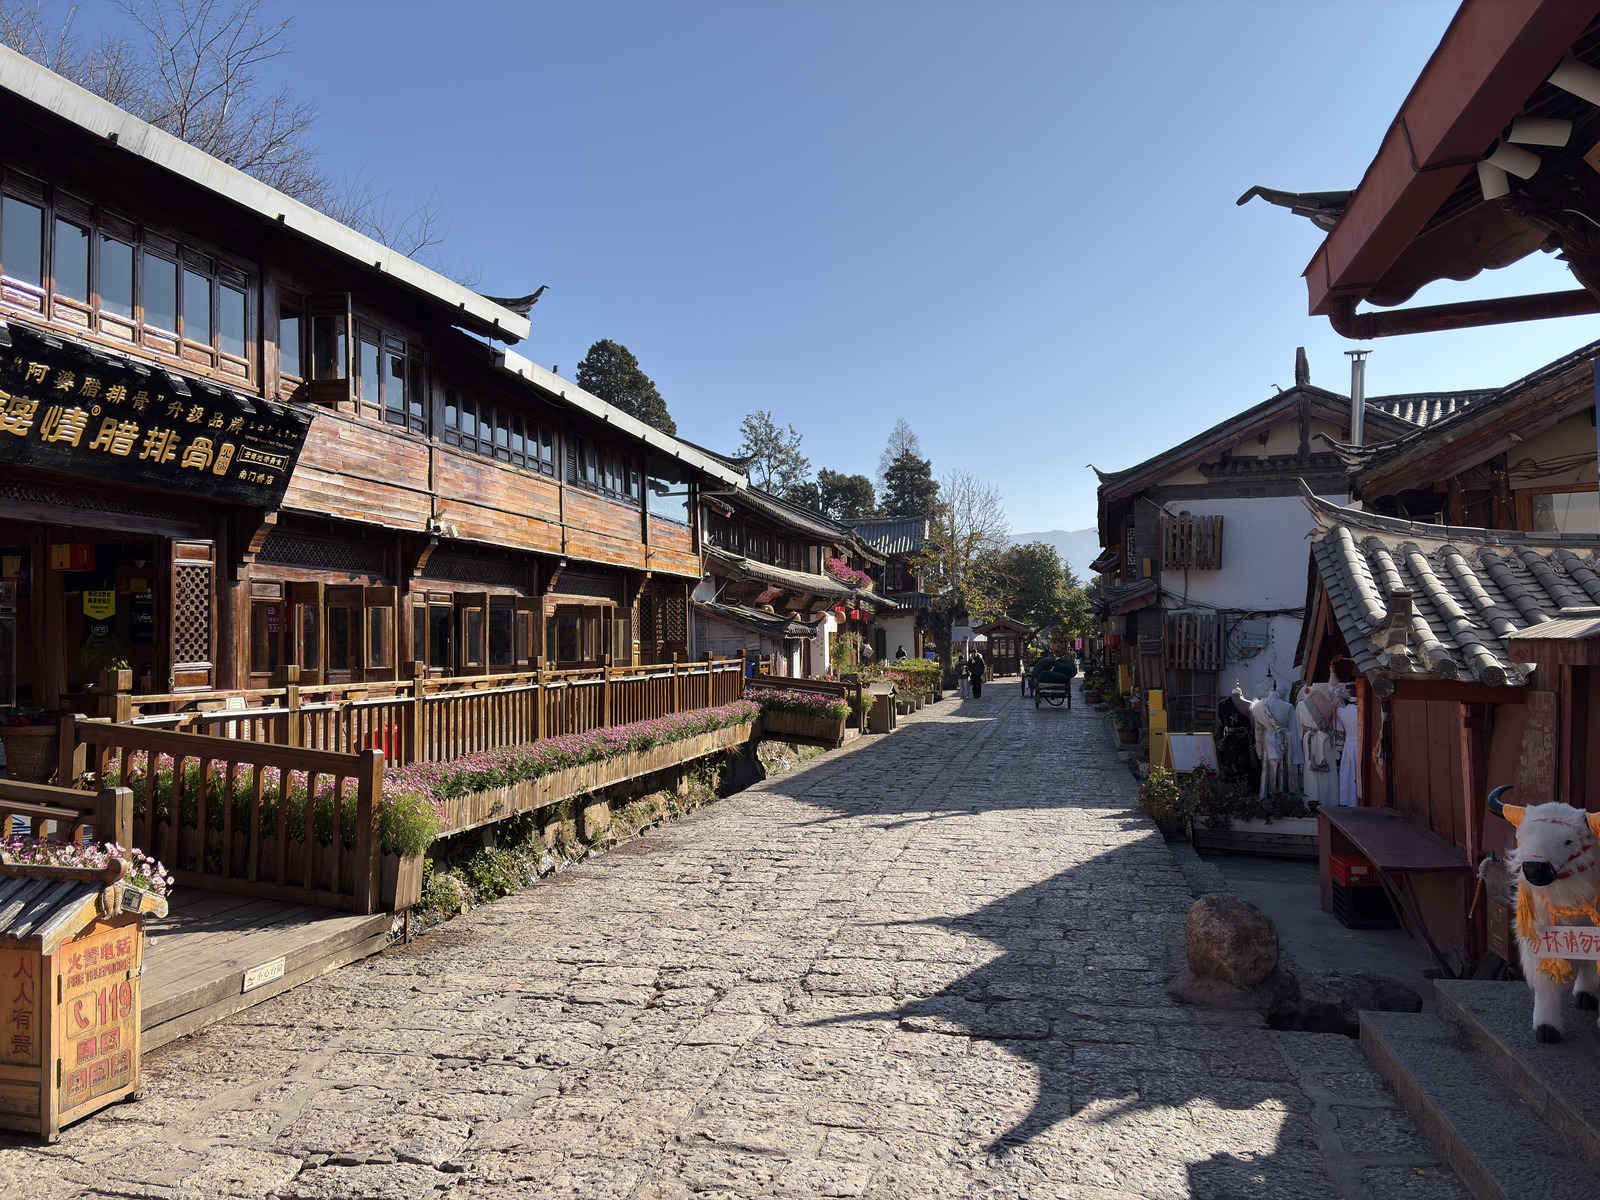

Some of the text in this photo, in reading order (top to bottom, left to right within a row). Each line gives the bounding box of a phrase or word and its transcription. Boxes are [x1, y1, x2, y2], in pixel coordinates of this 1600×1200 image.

[0, 356, 245, 434] “阿婆腊排骨”升级品牌
[67, 936, 132, 973] 火警电话
[67, 958, 131, 989] FIRE TELEPHONE
[12, 957, 33, 1056] 人人有责
[98, 981, 132, 1025] 119
